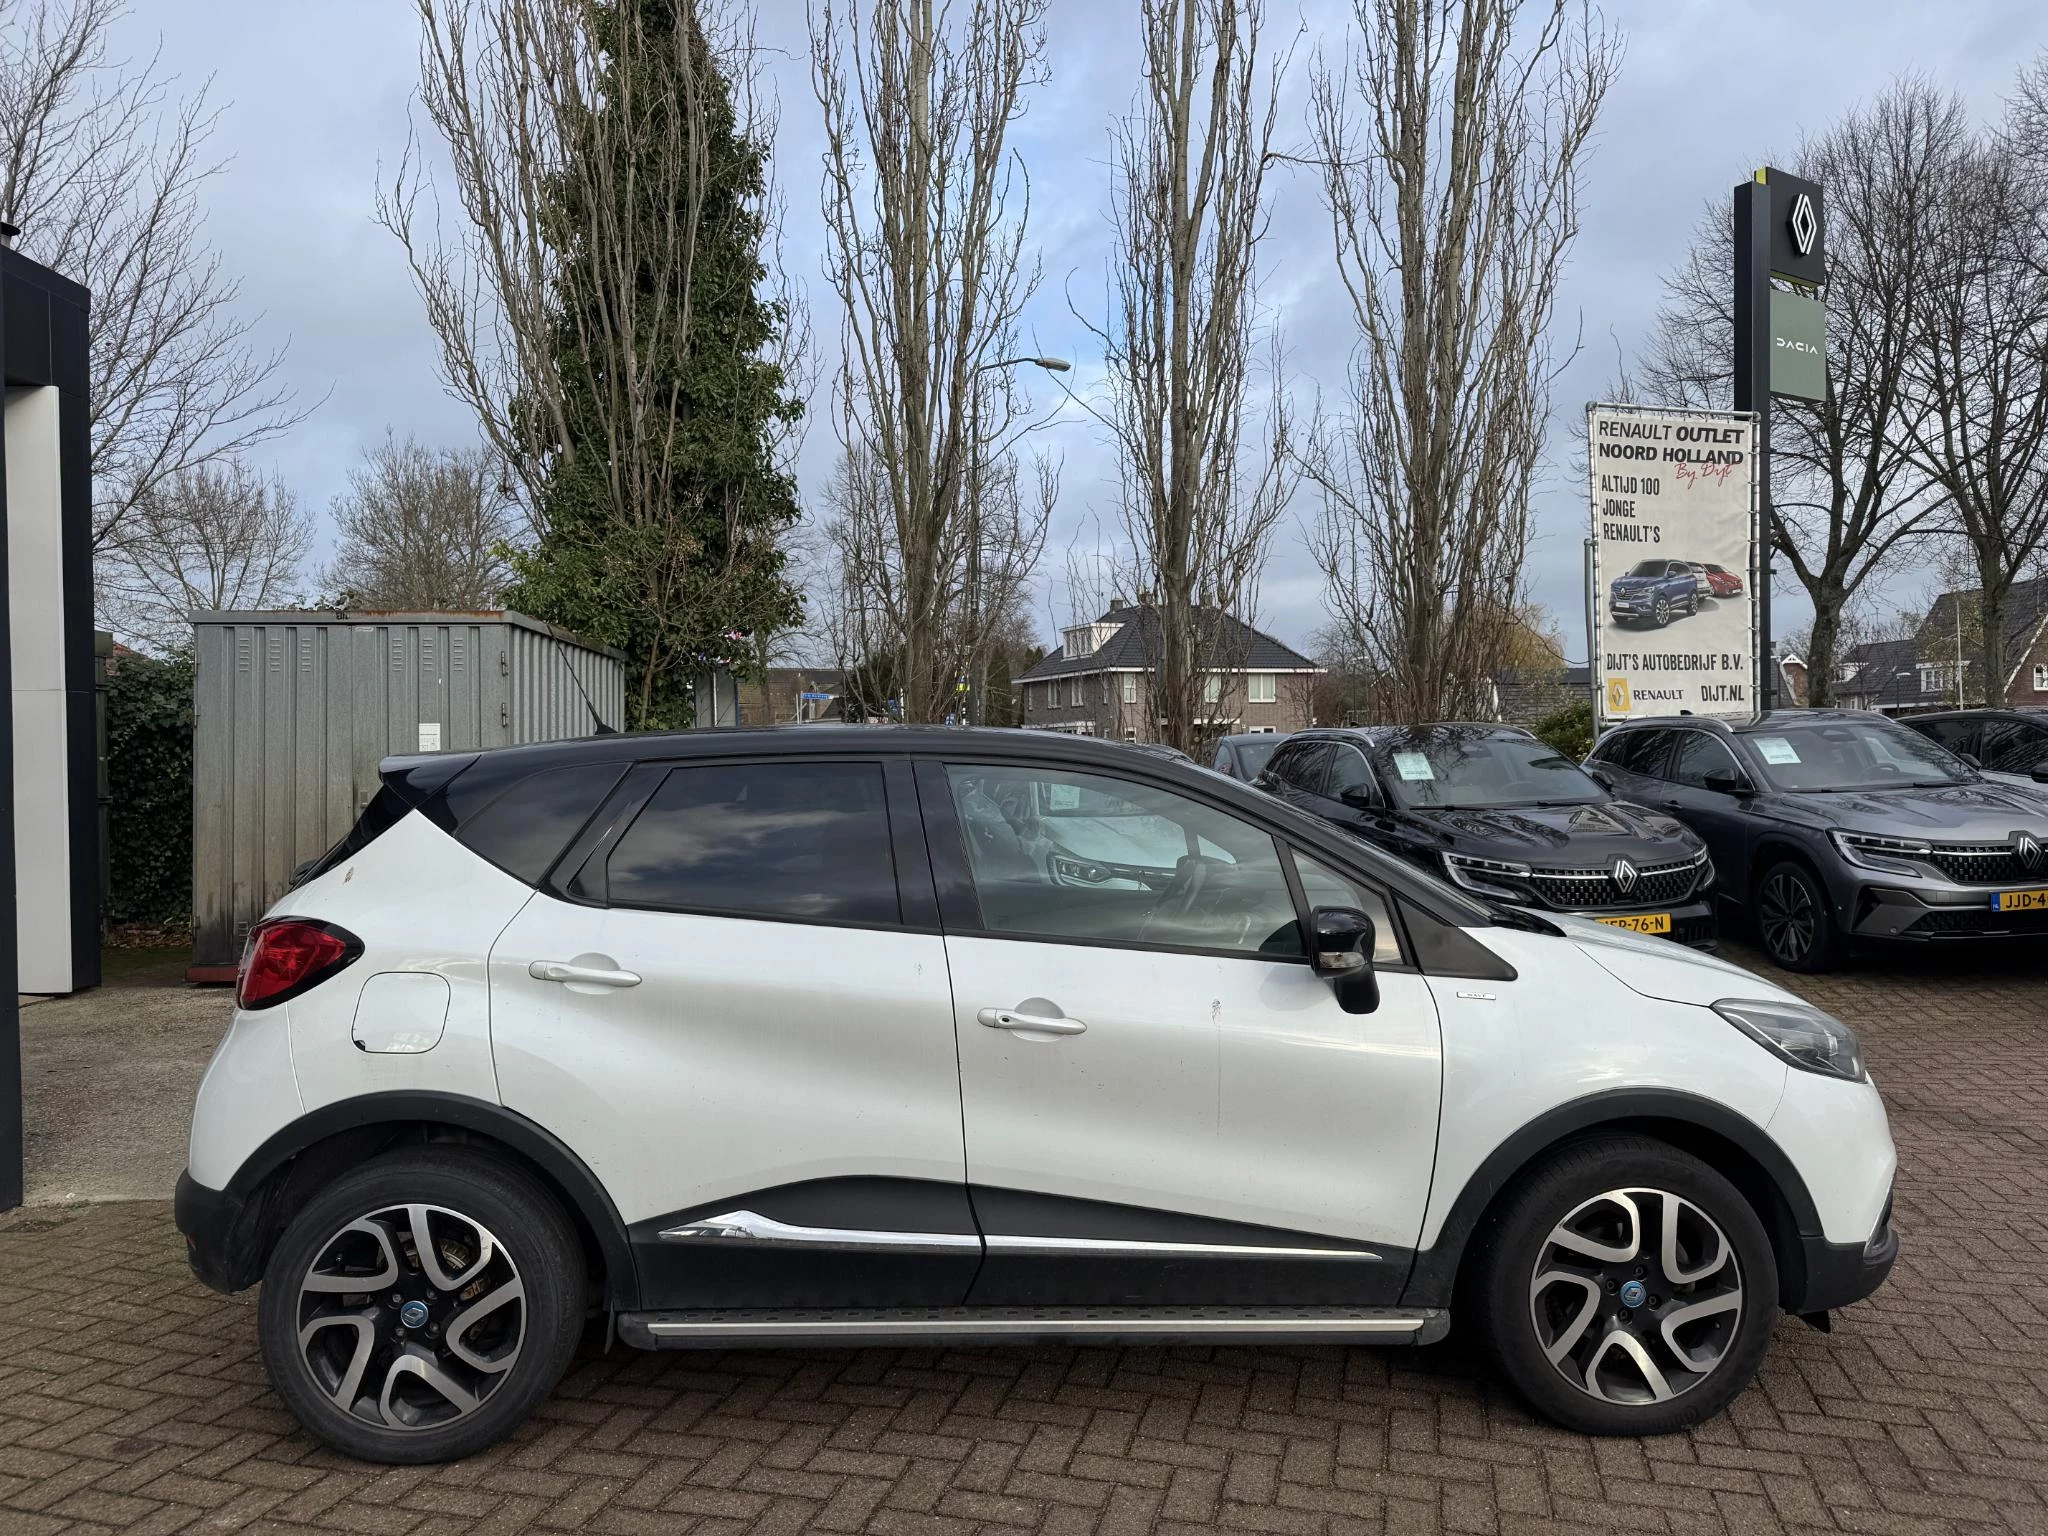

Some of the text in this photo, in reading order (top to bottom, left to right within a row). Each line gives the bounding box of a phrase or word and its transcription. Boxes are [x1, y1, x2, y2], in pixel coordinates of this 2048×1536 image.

[1776, 337, 1818, 355] DACIA
[1599, 420, 1744, 444] RENAULT OUTLET
[1599, 442, 1744, 465] NOORD HOLLAND
[1601, 474, 1660, 495] ALTIJD 100
[1674, 462, 1698, 490] By
[1602, 499, 1636, 518] JONGE
[1603, 523, 1661, 543] RENAULT'S
[1606, 653, 1744, 671] DIJT'S AUTOBEDRIJF B.V.
[1633, 685, 1744, 702] RENAULT DIJT.NL
[2005, 892, 2048, 909] JJD-4
